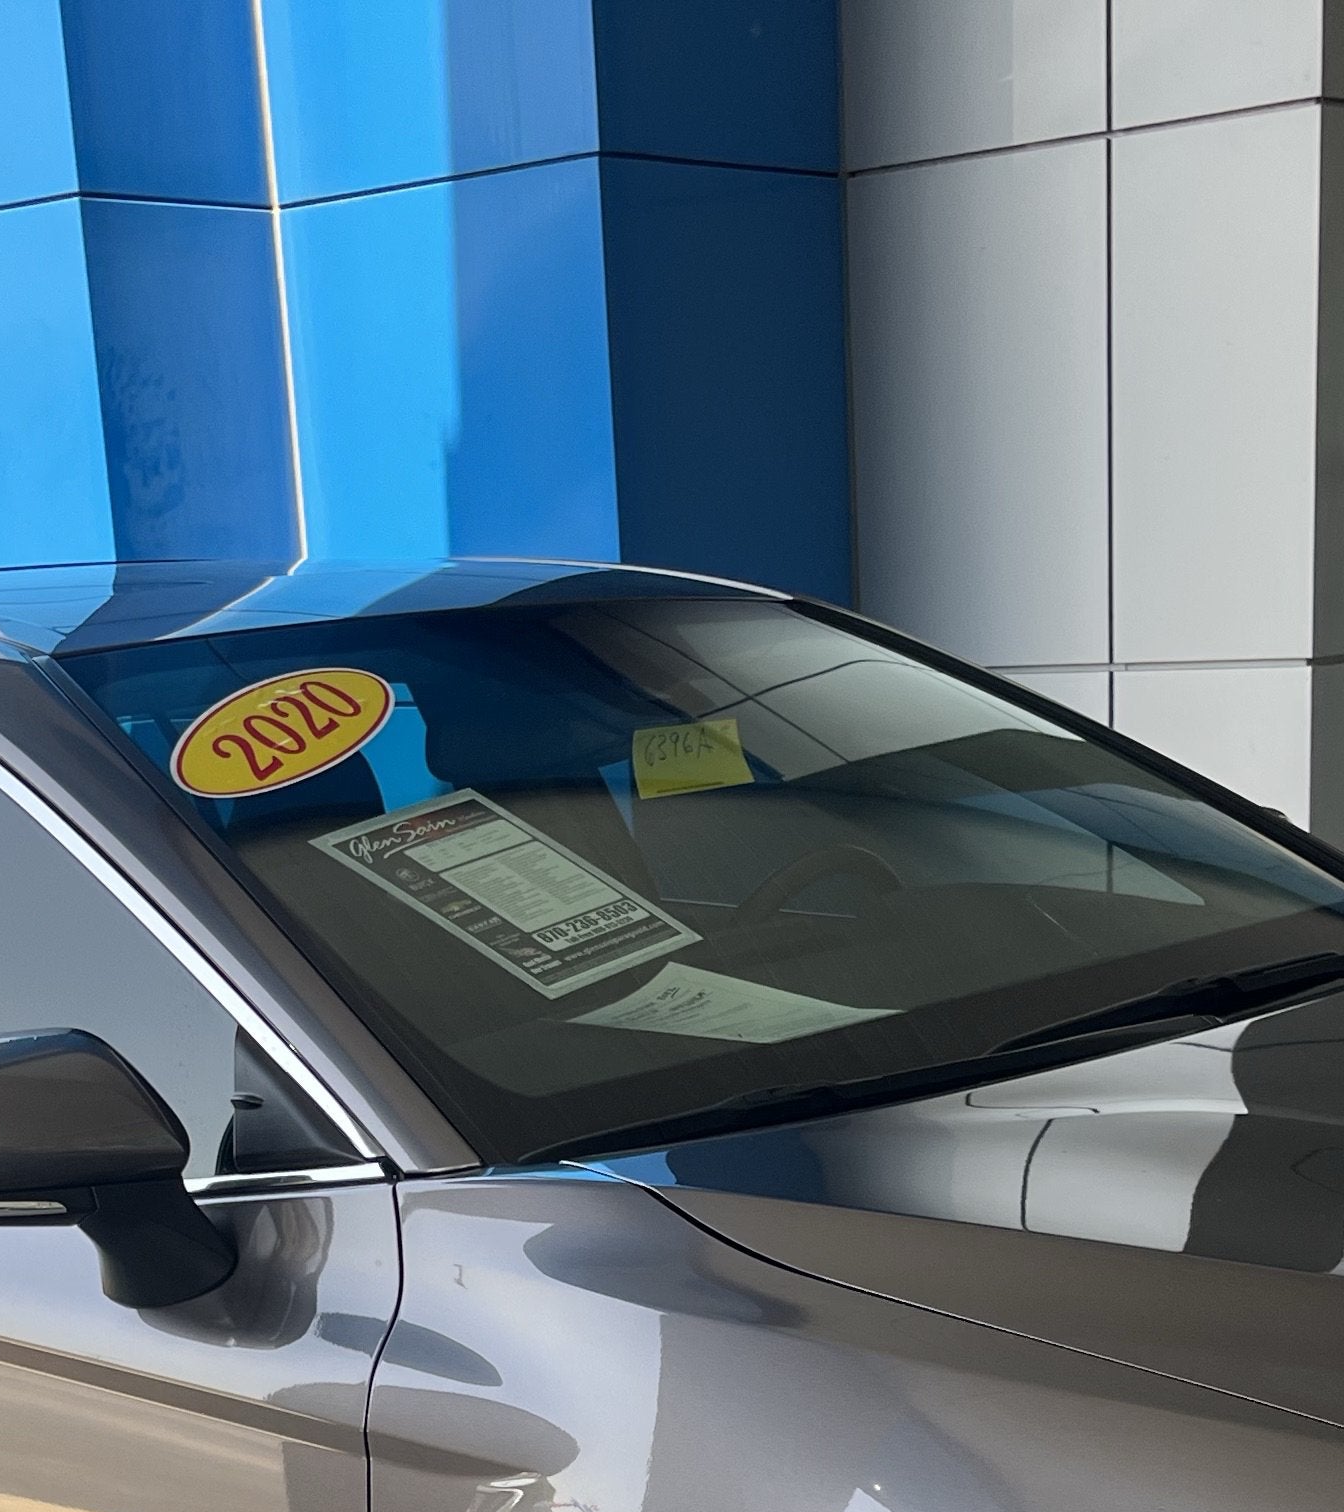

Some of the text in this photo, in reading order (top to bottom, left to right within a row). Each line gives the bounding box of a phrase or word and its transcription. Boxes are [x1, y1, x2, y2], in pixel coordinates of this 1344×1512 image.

[212, 681, 361, 781] 2020
[349, 835, 402, 864] Glen
[393, 818, 456, 844] Sain
[536, 901, 638, 943] 870-236-8503
